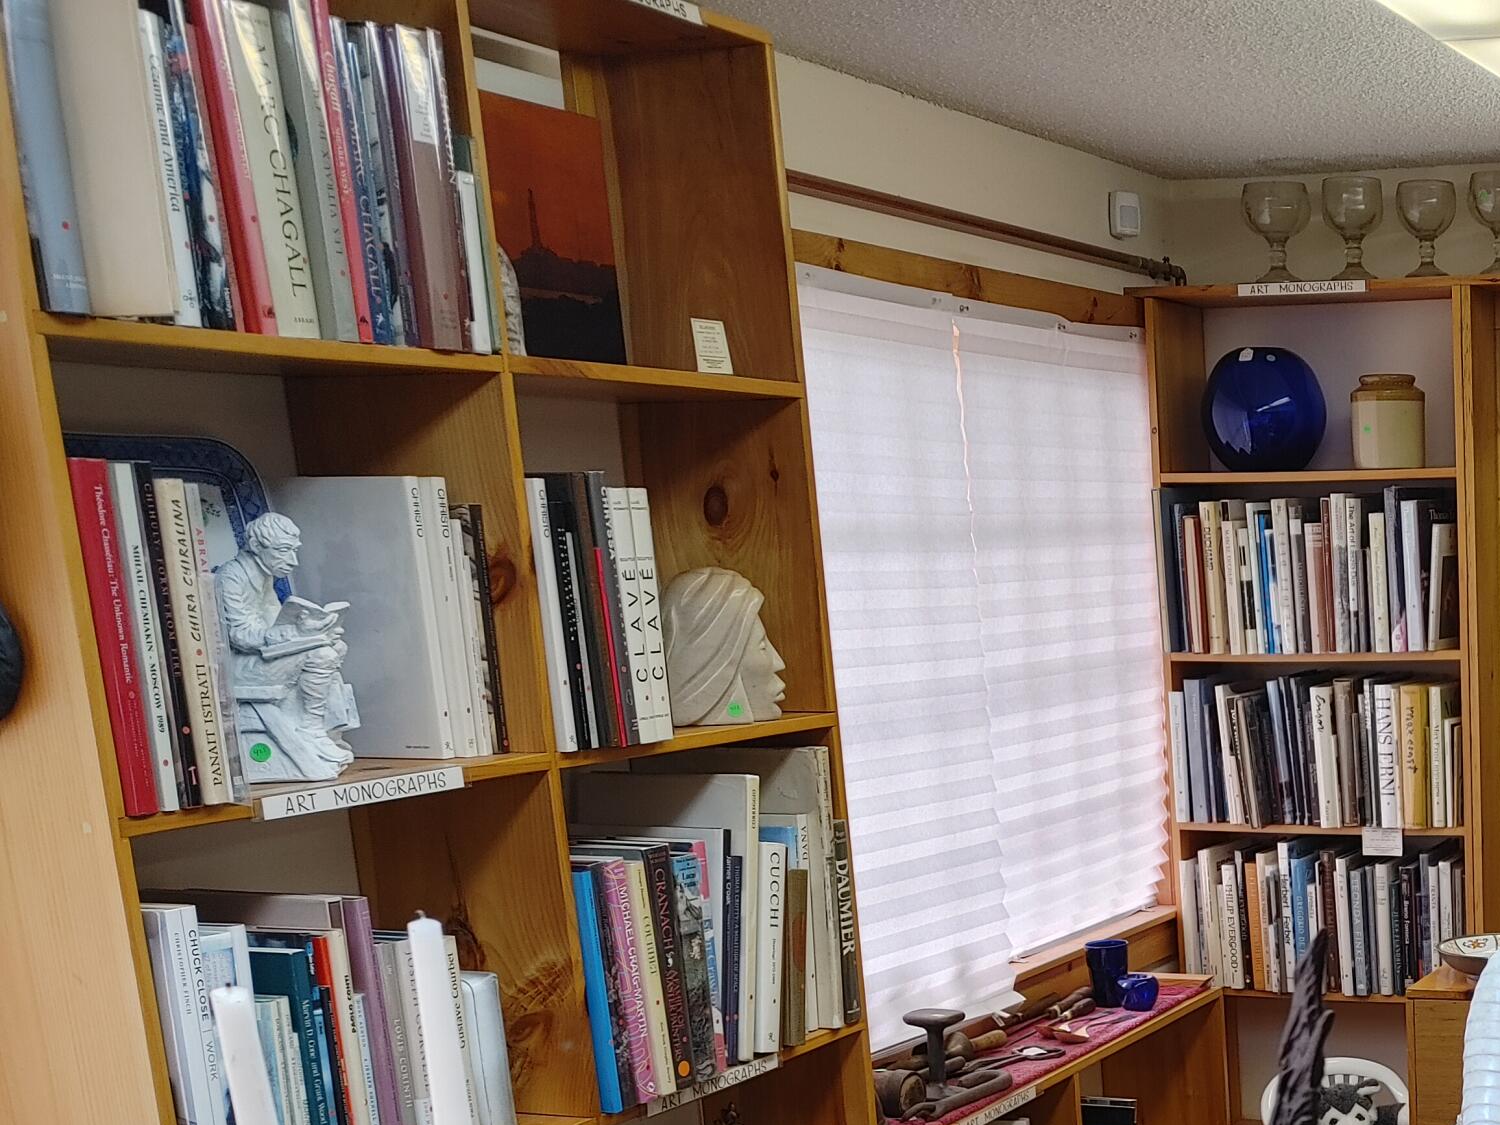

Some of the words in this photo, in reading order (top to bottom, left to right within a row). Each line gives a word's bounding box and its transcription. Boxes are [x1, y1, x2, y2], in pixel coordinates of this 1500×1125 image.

[322, 50, 341, 113] Chagall
[158, 120, 174, 147] and
[161, 151, 183, 212] America
[269, 149, 307, 297] CHAGALL
[360, 195, 383, 298] CHAGALL
[1249, 284, 1269, 295] ART
[1280, 281, 1354, 293] MONOGRAPHS
[94, 483, 107, 526] Théodore
[409, 486, 424, 538] CHRISTO
[437, 487, 450, 538] CHRISTO
[538, 488, 550, 538] CHRISTO
[601, 486, 616, 561] CHRYSSA
[171, 498, 192, 587] CHIRALINA
[1203, 526, 1214, 572] DUCHAMP
[1348, 522, 1356, 534] Art
[109, 579, 121, 596] The
[131, 544, 144, 586] MIHAIL
[156, 558, 171, 597] FORM
[111, 598, 125, 641] Unknown
[137, 589, 155, 652] CHEMIAKIN
[162, 602, 177, 641] FROM
[185, 593, 201, 643] CHIRA
[118, 642, 133, 684] Romantic
[170, 647, 182, 679] FIRE
[149, 663, 162, 710] MOSCOW
[195, 662, 212, 725] ISTRATI
[156, 714, 165, 734] 1989
[1375, 697, 1393, 745] HANS
[202, 729, 224, 787] PANAIT
[1379, 751, 1395, 797] ERNI
[284, 791, 319, 815] ART
[334, 771, 447, 806] MONOGRAPHS
[654, 867, 675, 949] CRANACH
[770, 851, 781, 929] CUCCHI
[834, 858, 856, 957] DAUMIER
[1224, 884, 1234, 915] PHILIP
[1280, 873, 1291, 909] Herbert
[187, 928, 203, 976] CHUCK
[1226, 916, 1239, 969] EVERGOOD
[1283, 915, 1292, 946] Ferber
[1354, 931, 1364, 963] FINKE
[173, 930, 188, 989] CHRISTOPHER
[181, 989, 192, 1015] FINCH
[404, 950, 420, 1008] JOSEPH
[618, 886, 633, 943] MICHAEL
[626, 946, 649, 1038] CRAIG-MARTIN
[731, 972, 739, 993] SPACE
[193, 978, 210, 1022] CLOSE
[344, 974, 352, 1001] CONTI
[447, 952, 458, 999] Courbet
[454, 1002, 466, 1050] Gustave
[300, 999, 312, 1028] Marvin
[347, 1003, 357, 1034] PAOLO
[204, 1039, 219, 1081] WORK
[307, 1039, 317, 1060] Cone
[311, 1061, 321, 1078] and
[393, 1017, 405, 1052] LOVIS
[399, 1056, 414, 1108] CORINTH
[661, 1092, 683, 1111] ART
[692, 1058, 769, 1099] MONOGRAPHS
[318, 1102, 328, 1125] Wood
